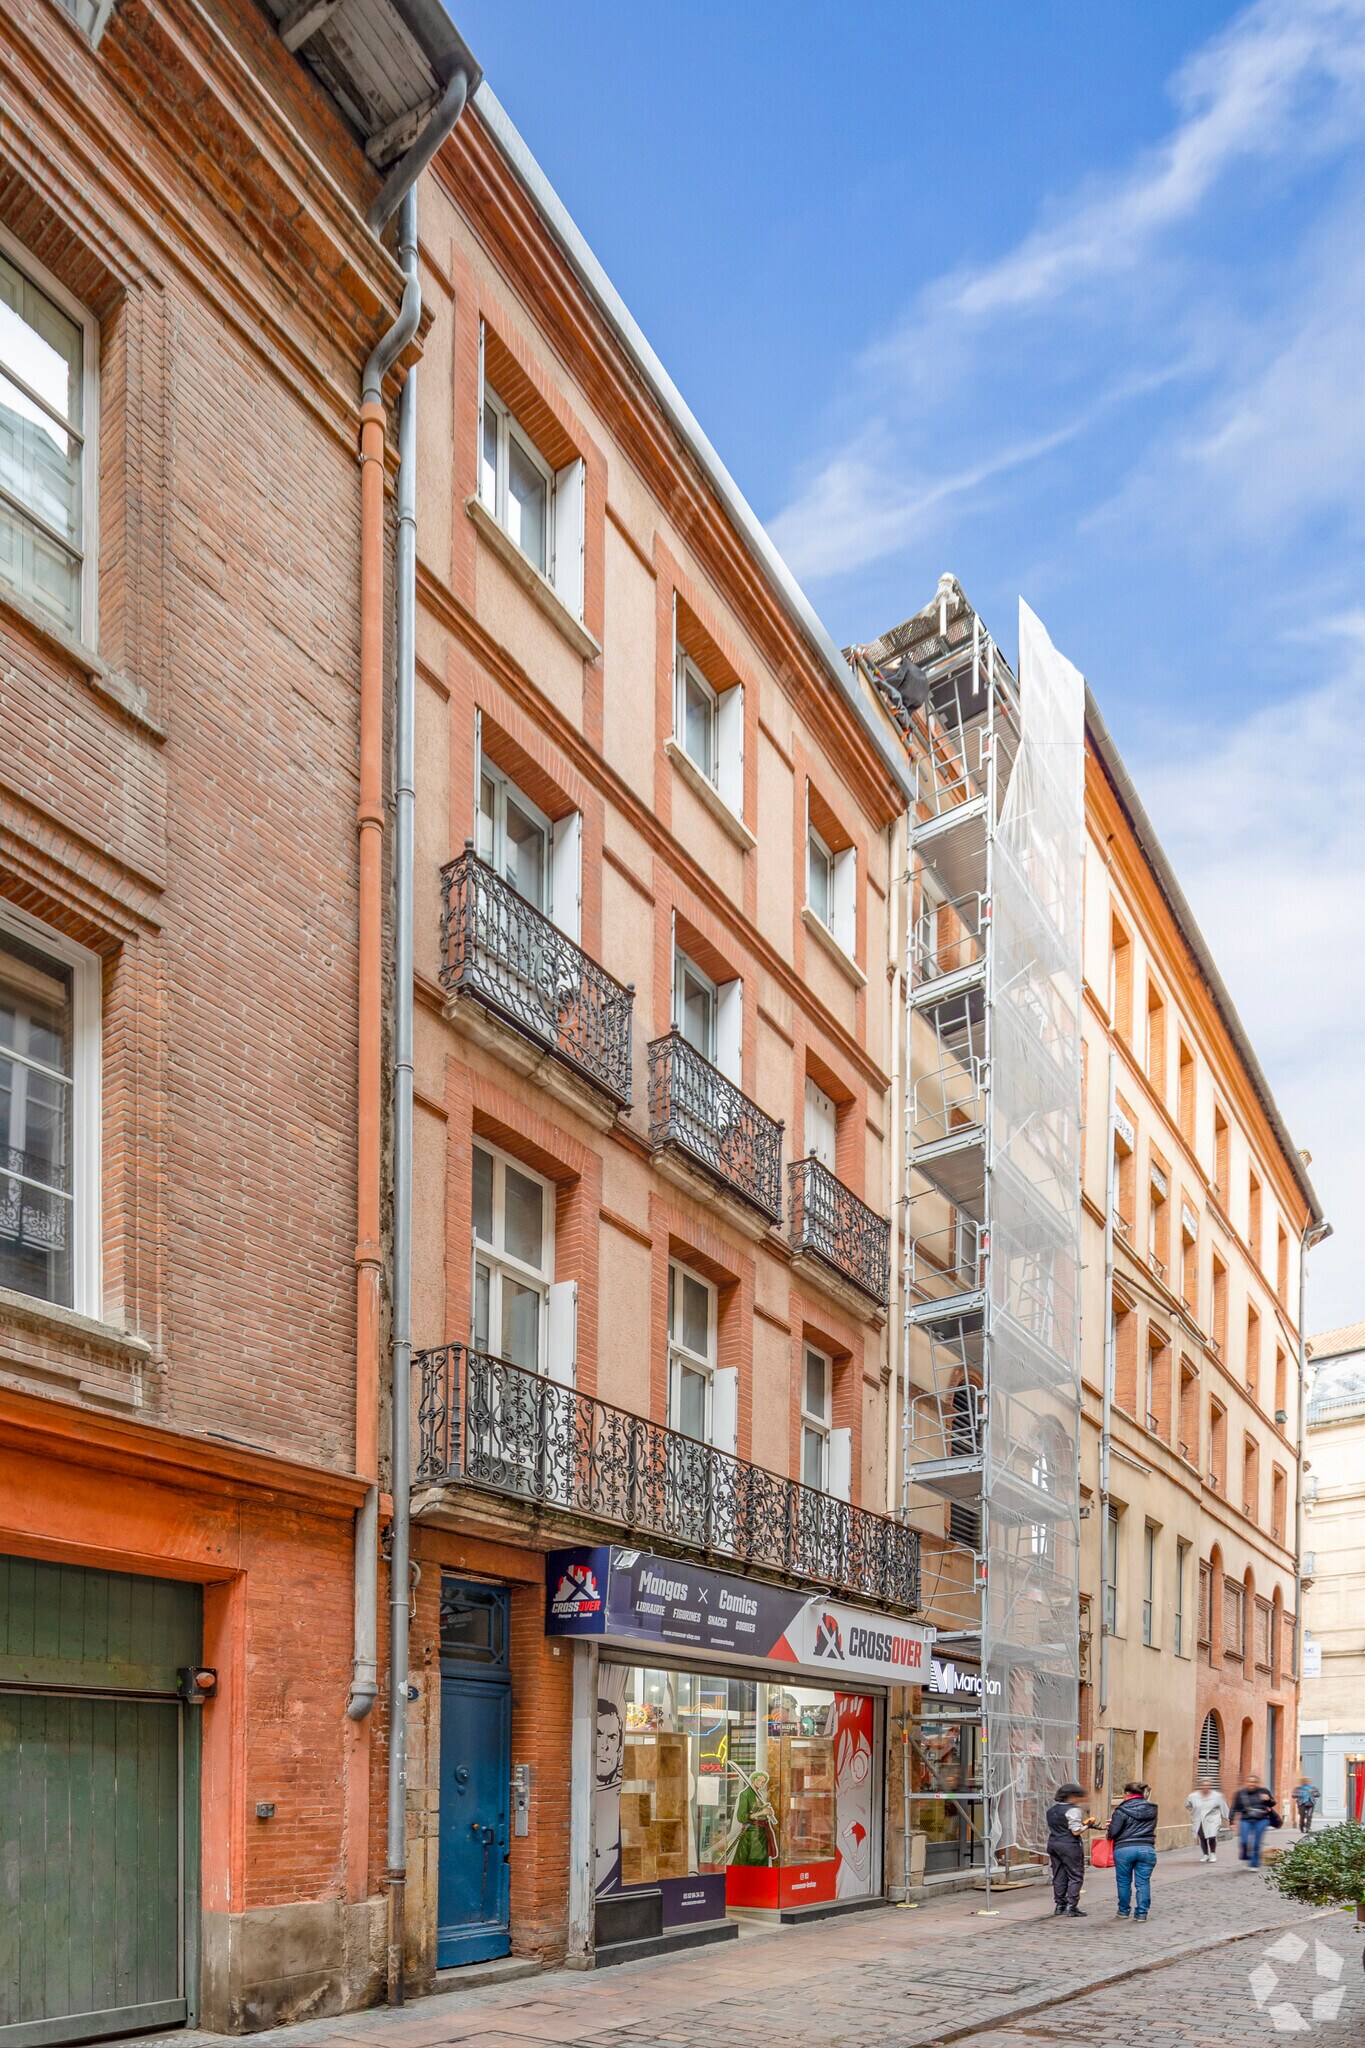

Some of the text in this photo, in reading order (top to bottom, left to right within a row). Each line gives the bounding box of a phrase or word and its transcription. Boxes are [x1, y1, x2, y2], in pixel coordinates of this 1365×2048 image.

[552, 1600, 601, 1613] CROSSOVER
[638, 1570, 689, 1601] Mangas
[719, 1589, 758, 1616] Comics
[636, 1600, 666, 1616] LIBRAIRIE
[673, 1608, 702, 1623] FIGURINES
[707, 1615, 728, 1628] SNACKS
[848, 1626, 922, 1668] CROSSOVER
